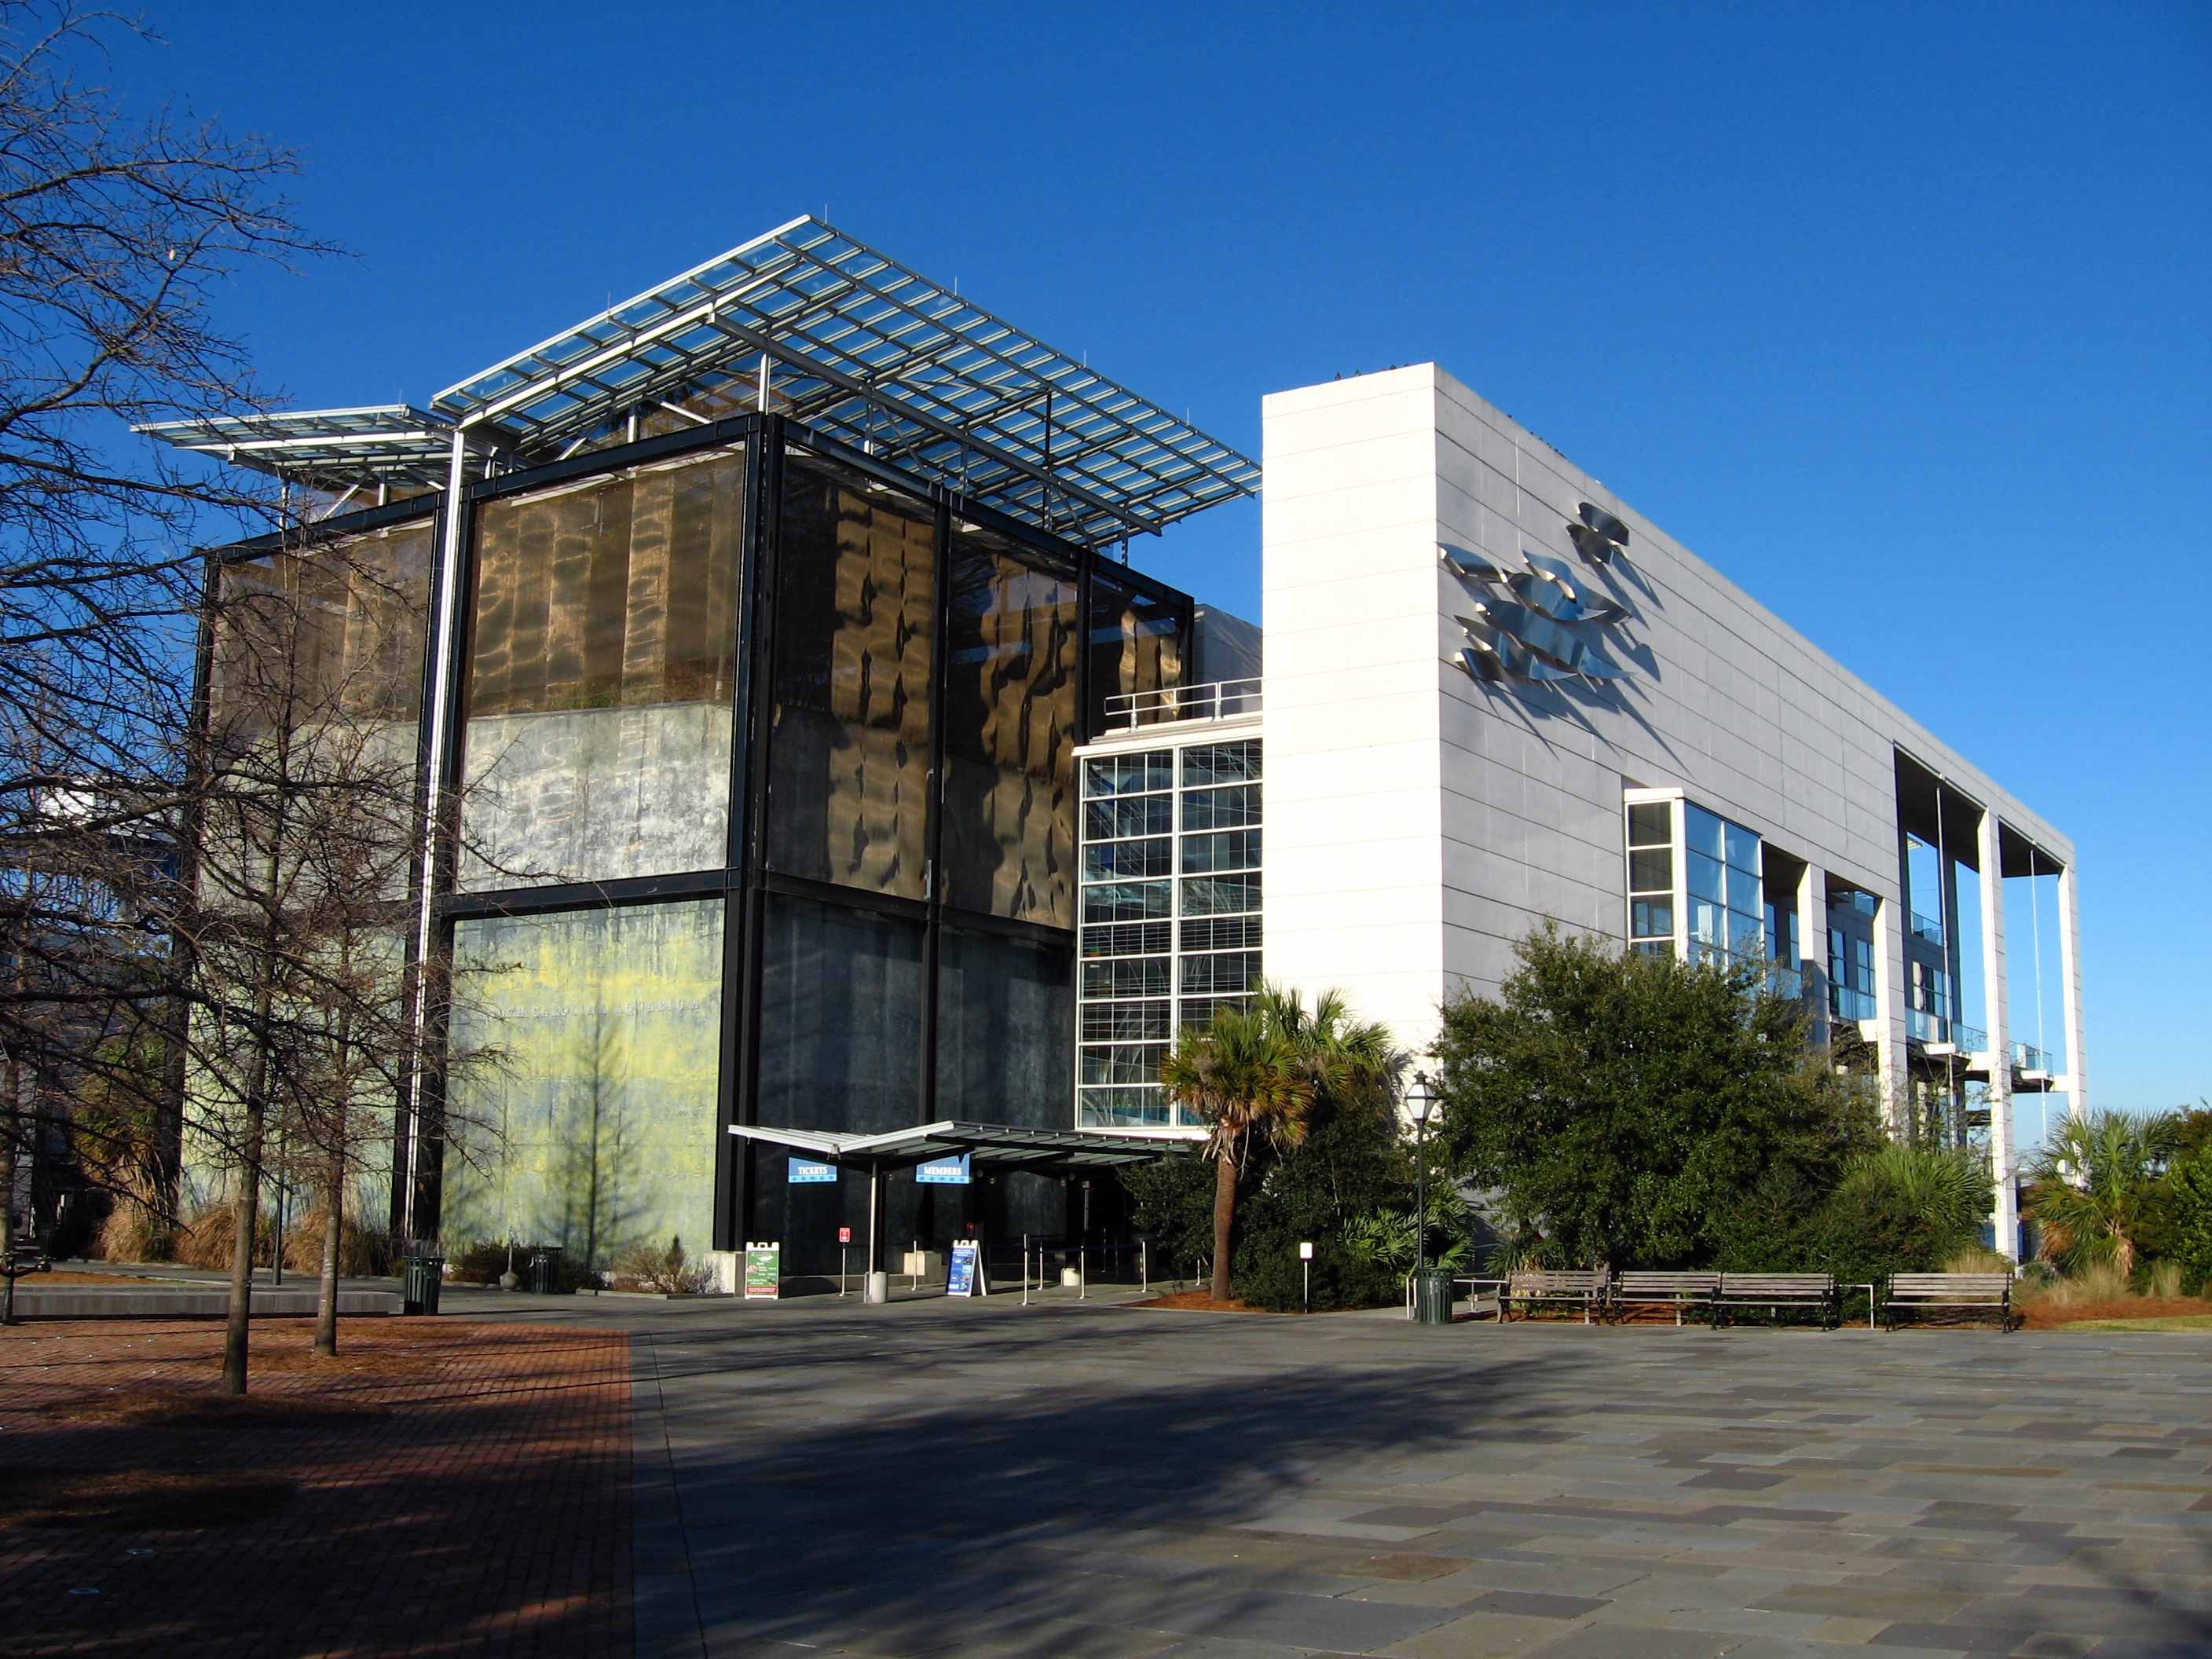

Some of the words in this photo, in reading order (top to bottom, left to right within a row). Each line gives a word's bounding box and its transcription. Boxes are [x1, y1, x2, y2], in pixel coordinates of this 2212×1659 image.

[614, 999, 700, 1016] AQUARIUM
[797, 1166, 828, 1175] TICKETS
[924, 1166, 962, 1176] MEMBERS
